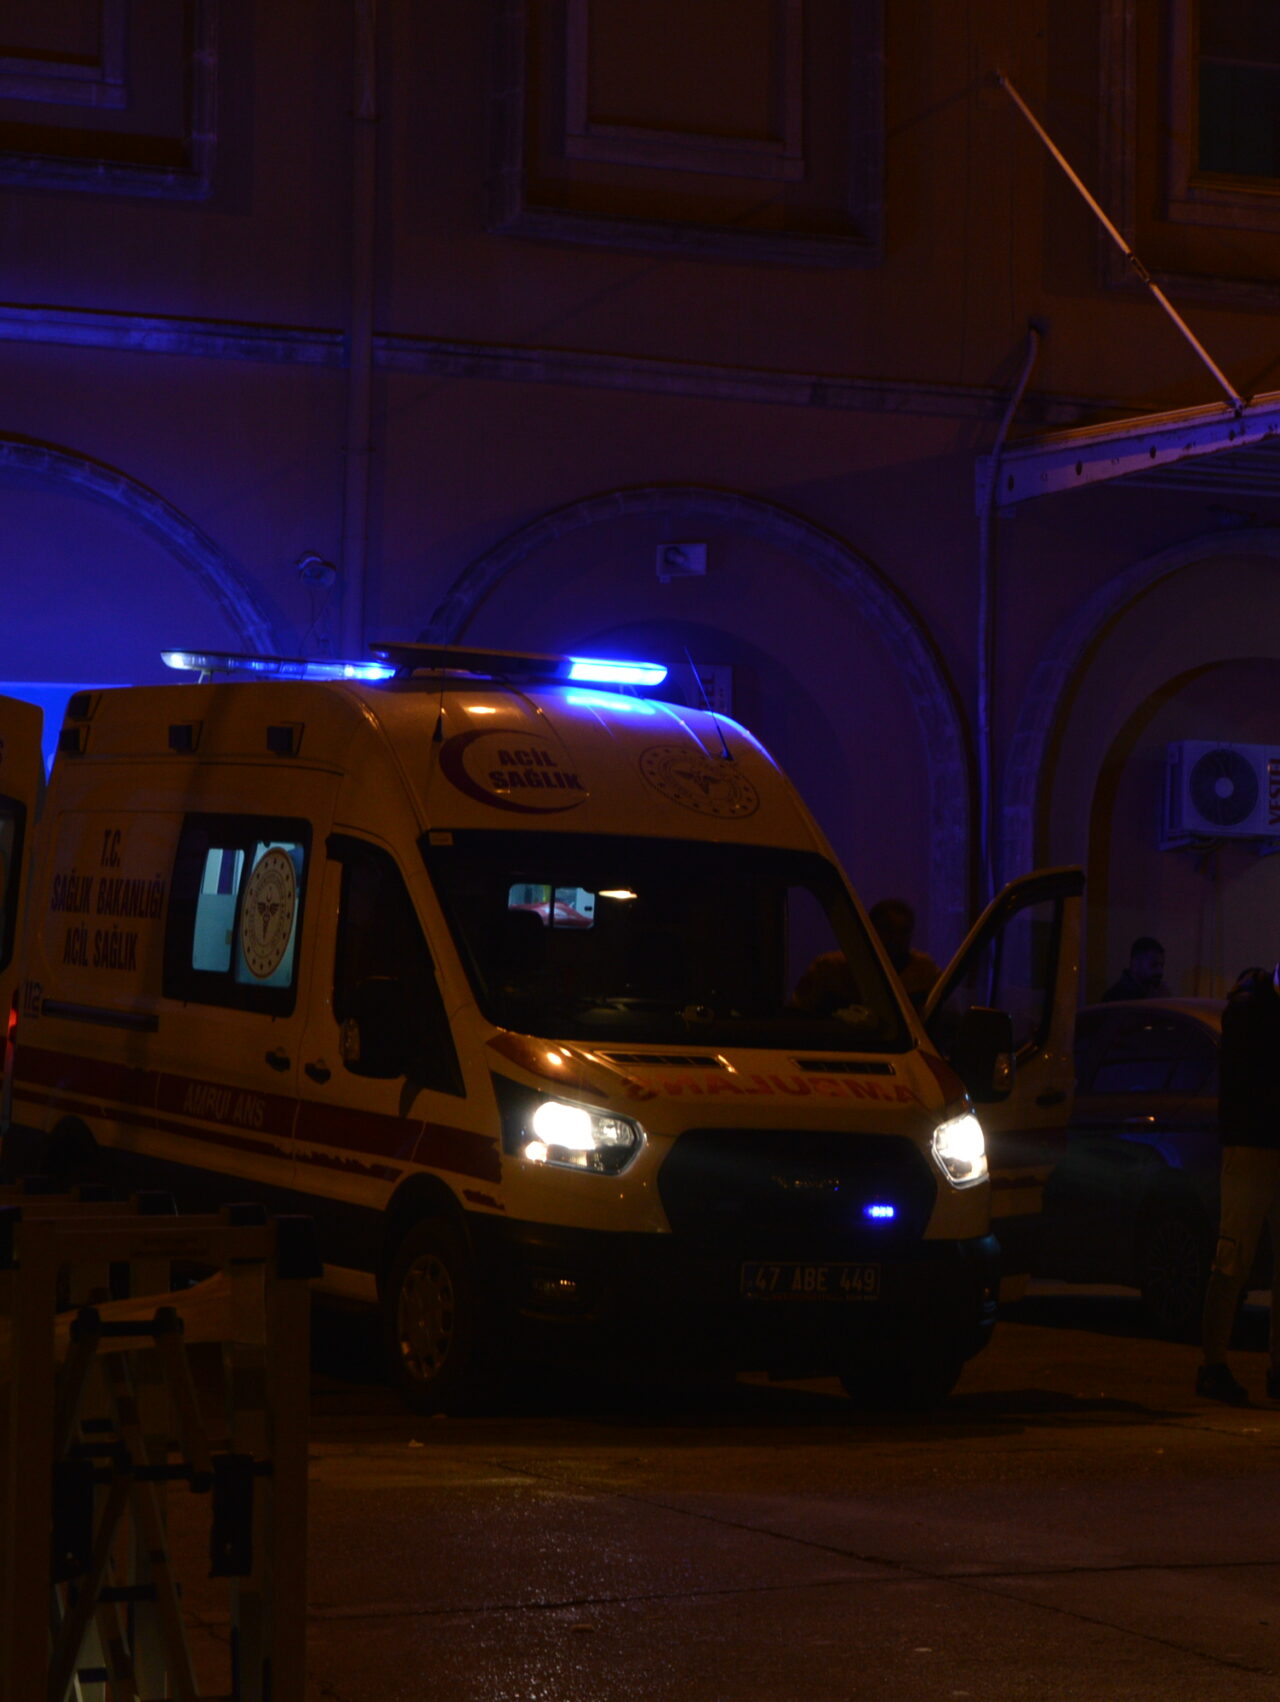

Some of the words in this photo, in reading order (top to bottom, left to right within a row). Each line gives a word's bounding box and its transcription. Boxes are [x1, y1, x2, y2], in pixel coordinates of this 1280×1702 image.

[489, 768, 584, 790] SAĞLIK
[101, 829, 121, 867] T.C.
[51, 868, 93, 914] SAĞLIK
[97, 873, 165, 920] BAKANLIĞI
[63, 922, 89, 968] ACİL
[93, 925, 138, 971] SAĞLIK
[183, 1082, 266, 1127] AMBULANS
[755, 1266, 781, 1291] 47
[791, 1266, 829, 1292] ABE
[840, 1267, 876, 1292] 449
